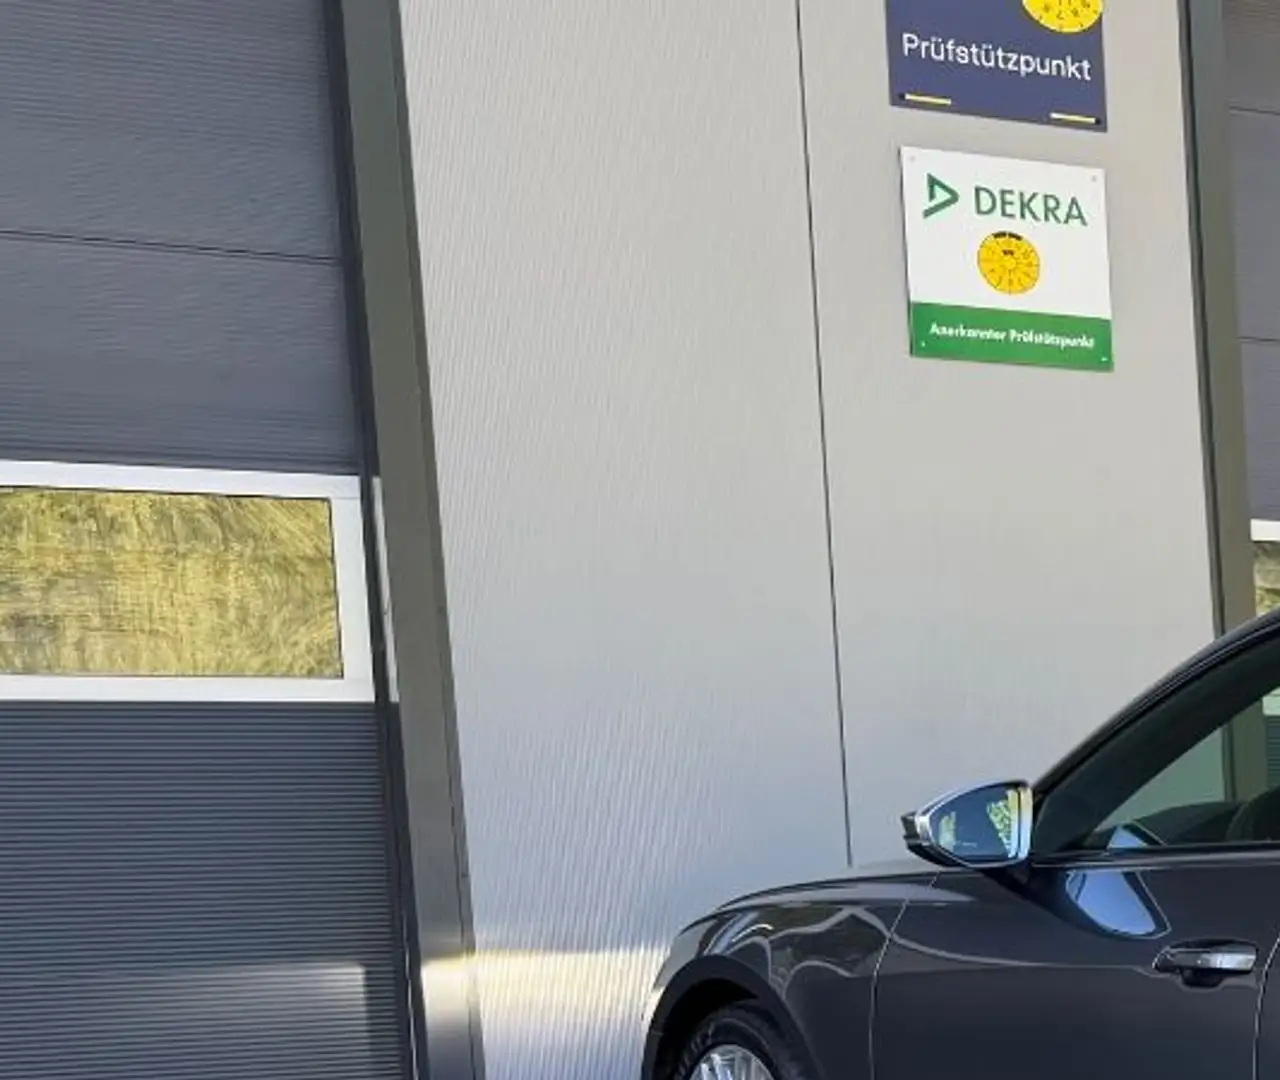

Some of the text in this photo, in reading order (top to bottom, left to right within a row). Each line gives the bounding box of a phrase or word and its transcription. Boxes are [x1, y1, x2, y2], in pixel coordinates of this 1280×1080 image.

[902, 33, 1092, 81] Prüfstützpunkt
[974, 185, 1088, 226] DEKRA
[1009, 328, 1096, 350] Prüfstützpunkt
